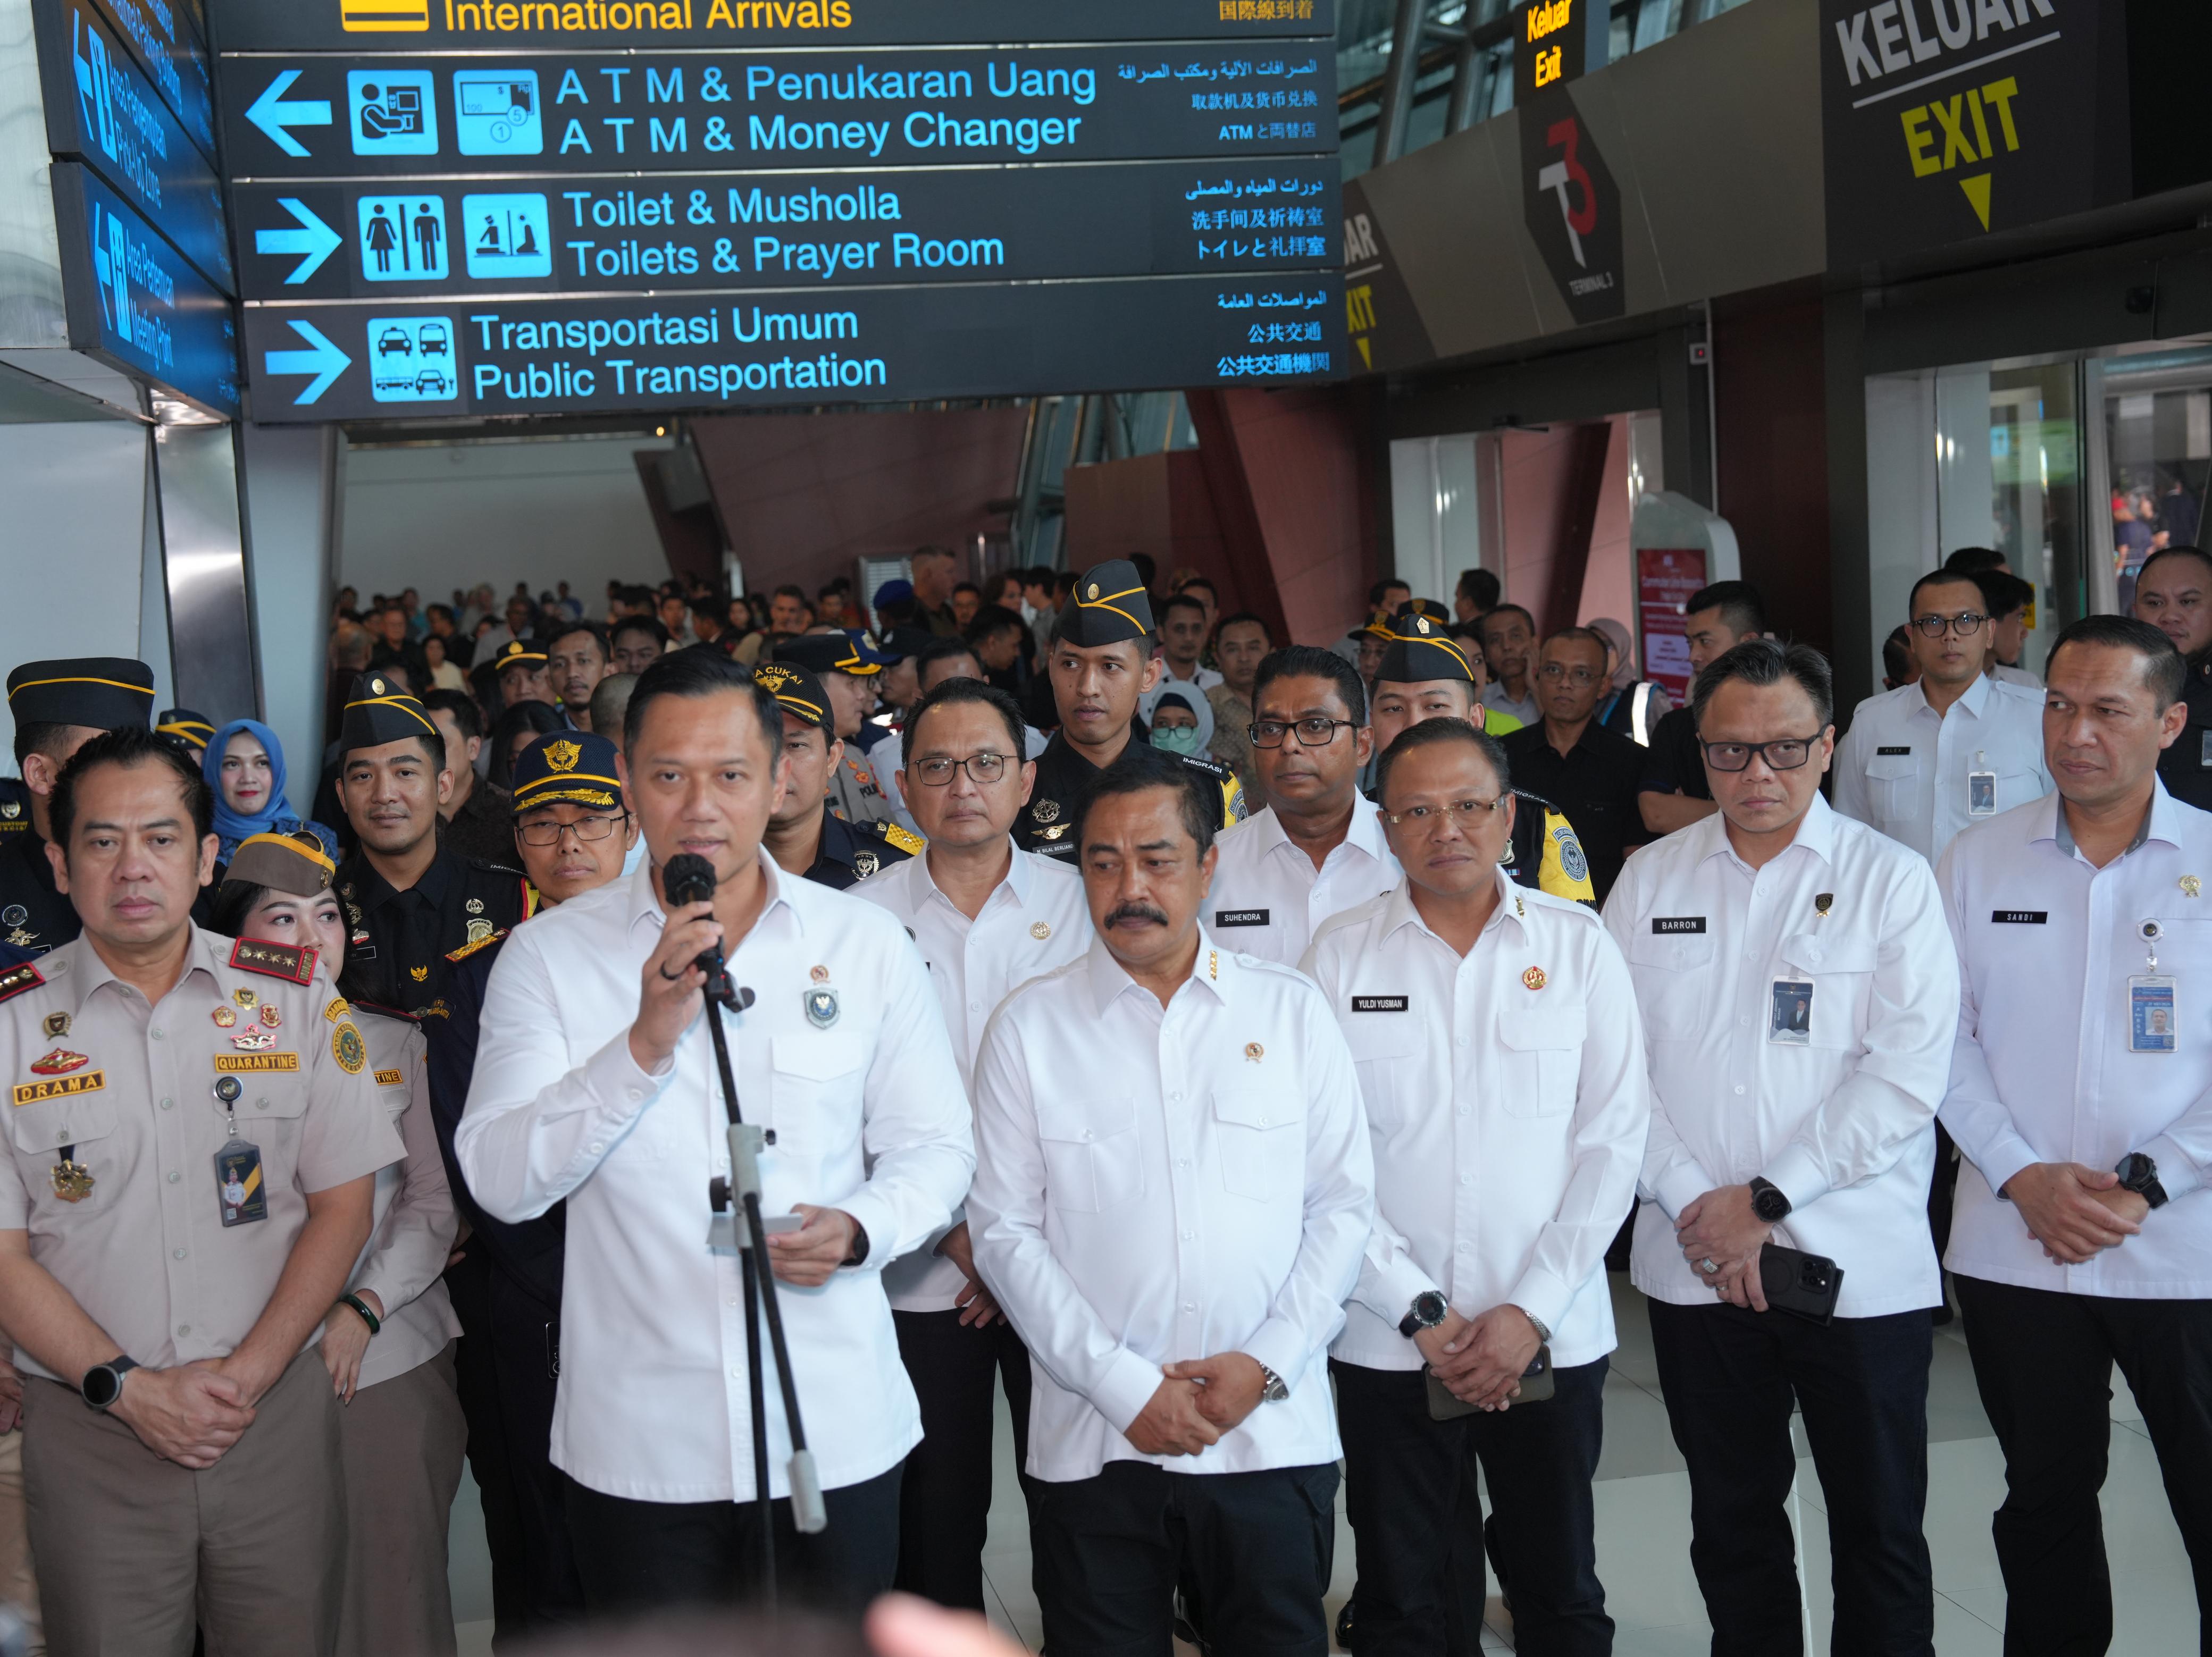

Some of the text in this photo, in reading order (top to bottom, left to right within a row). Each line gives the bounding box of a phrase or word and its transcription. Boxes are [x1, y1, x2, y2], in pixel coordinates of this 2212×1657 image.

[445, 0, 852, 31] International Arrivals
[1527, 0, 1572, 43] Keluar
[108, 49, 128, 114] Area
[700, 66, 732, 102] &
[747, 64, 973, 101] Penukaran
[988, 62, 1096, 105] Uang
[1535, 46, 1562, 88] Exit
[703, 115, 735, 152] &
[748, 114, 891, 157] Money
[903, 111, 1082, 155] Changer
[1218, 124, 1253, 140] ATM
[1900, 75, 2020, 178] EXIT
[141, 151, 162, 209] Zone
[562, 184, 902, 227] Toilet & Musholla
[1191, 206, 1325, 231] 洗手间及祈祷室
[127, 228, 143, 286] Area
[142, 242, 175, 310] Pertemuan
[566, 232, 1004, 279] Toilets & Prayer Room
[1569, 271, 1614, 296] TERMINAL 3
[130, 297, 174, 372] Meeting Point
[470, 306, 858, 356] Transportasi Umum
[1247, 321, 1322, 344] 公共交通
[474, 352, 886, 400] Public Transportation
[765, 666, 803, 685] CUKAI
[1183, 756, 1222, 774] IMIGRASI
[1224, 913, 1261, 922] SUHENDRA
[1662, 921, 1697, 930] BARRON
[1358, 999, 1403, 1008] YULDI YUSMAN
[219, 1055, 296, 1070] QUARANTINE
[21, 1075, 98, 1101] DRAMA
